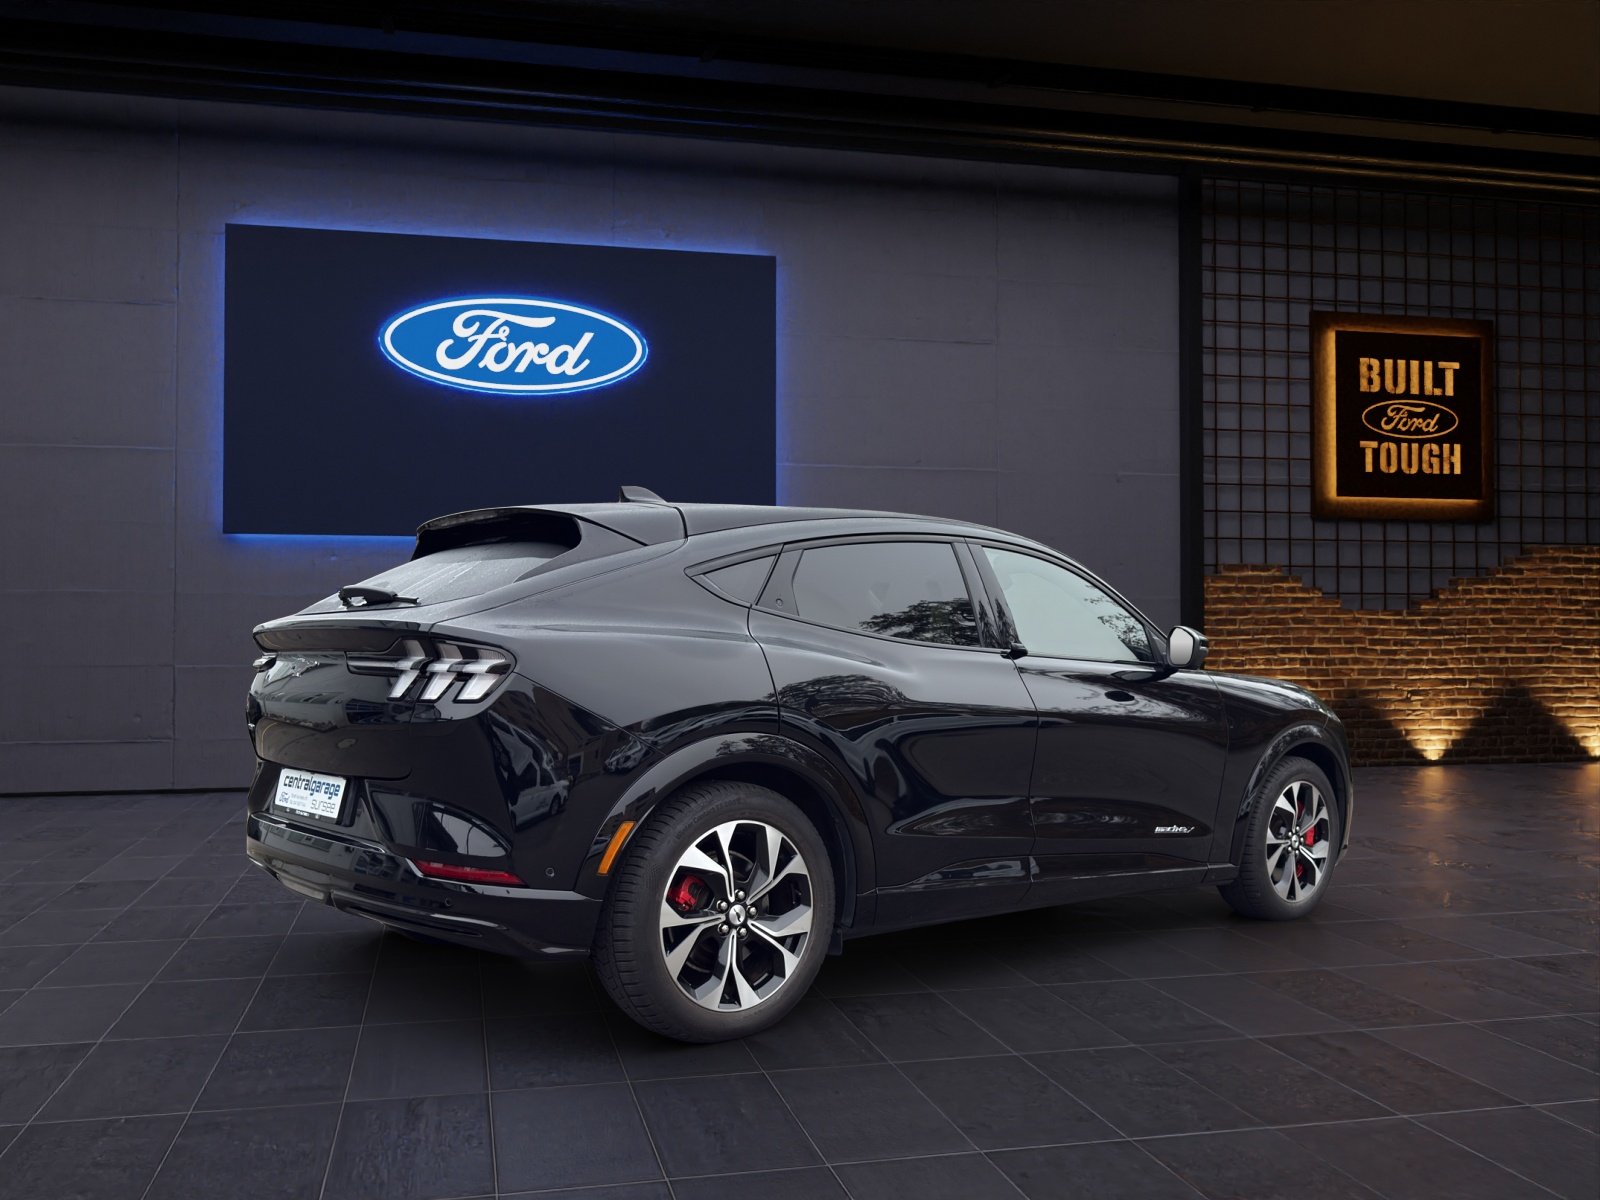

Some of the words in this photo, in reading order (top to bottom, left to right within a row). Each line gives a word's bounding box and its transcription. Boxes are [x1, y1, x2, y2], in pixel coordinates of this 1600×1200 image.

[435, 309, 595, 376] Ford
[1359, 357, 1460, 396] BUILT
[1380, 404, 1441, 432] Ford
[1359, 440, 1461, 475] TOUGH
[283, 774, 341, 800] centralgarage
